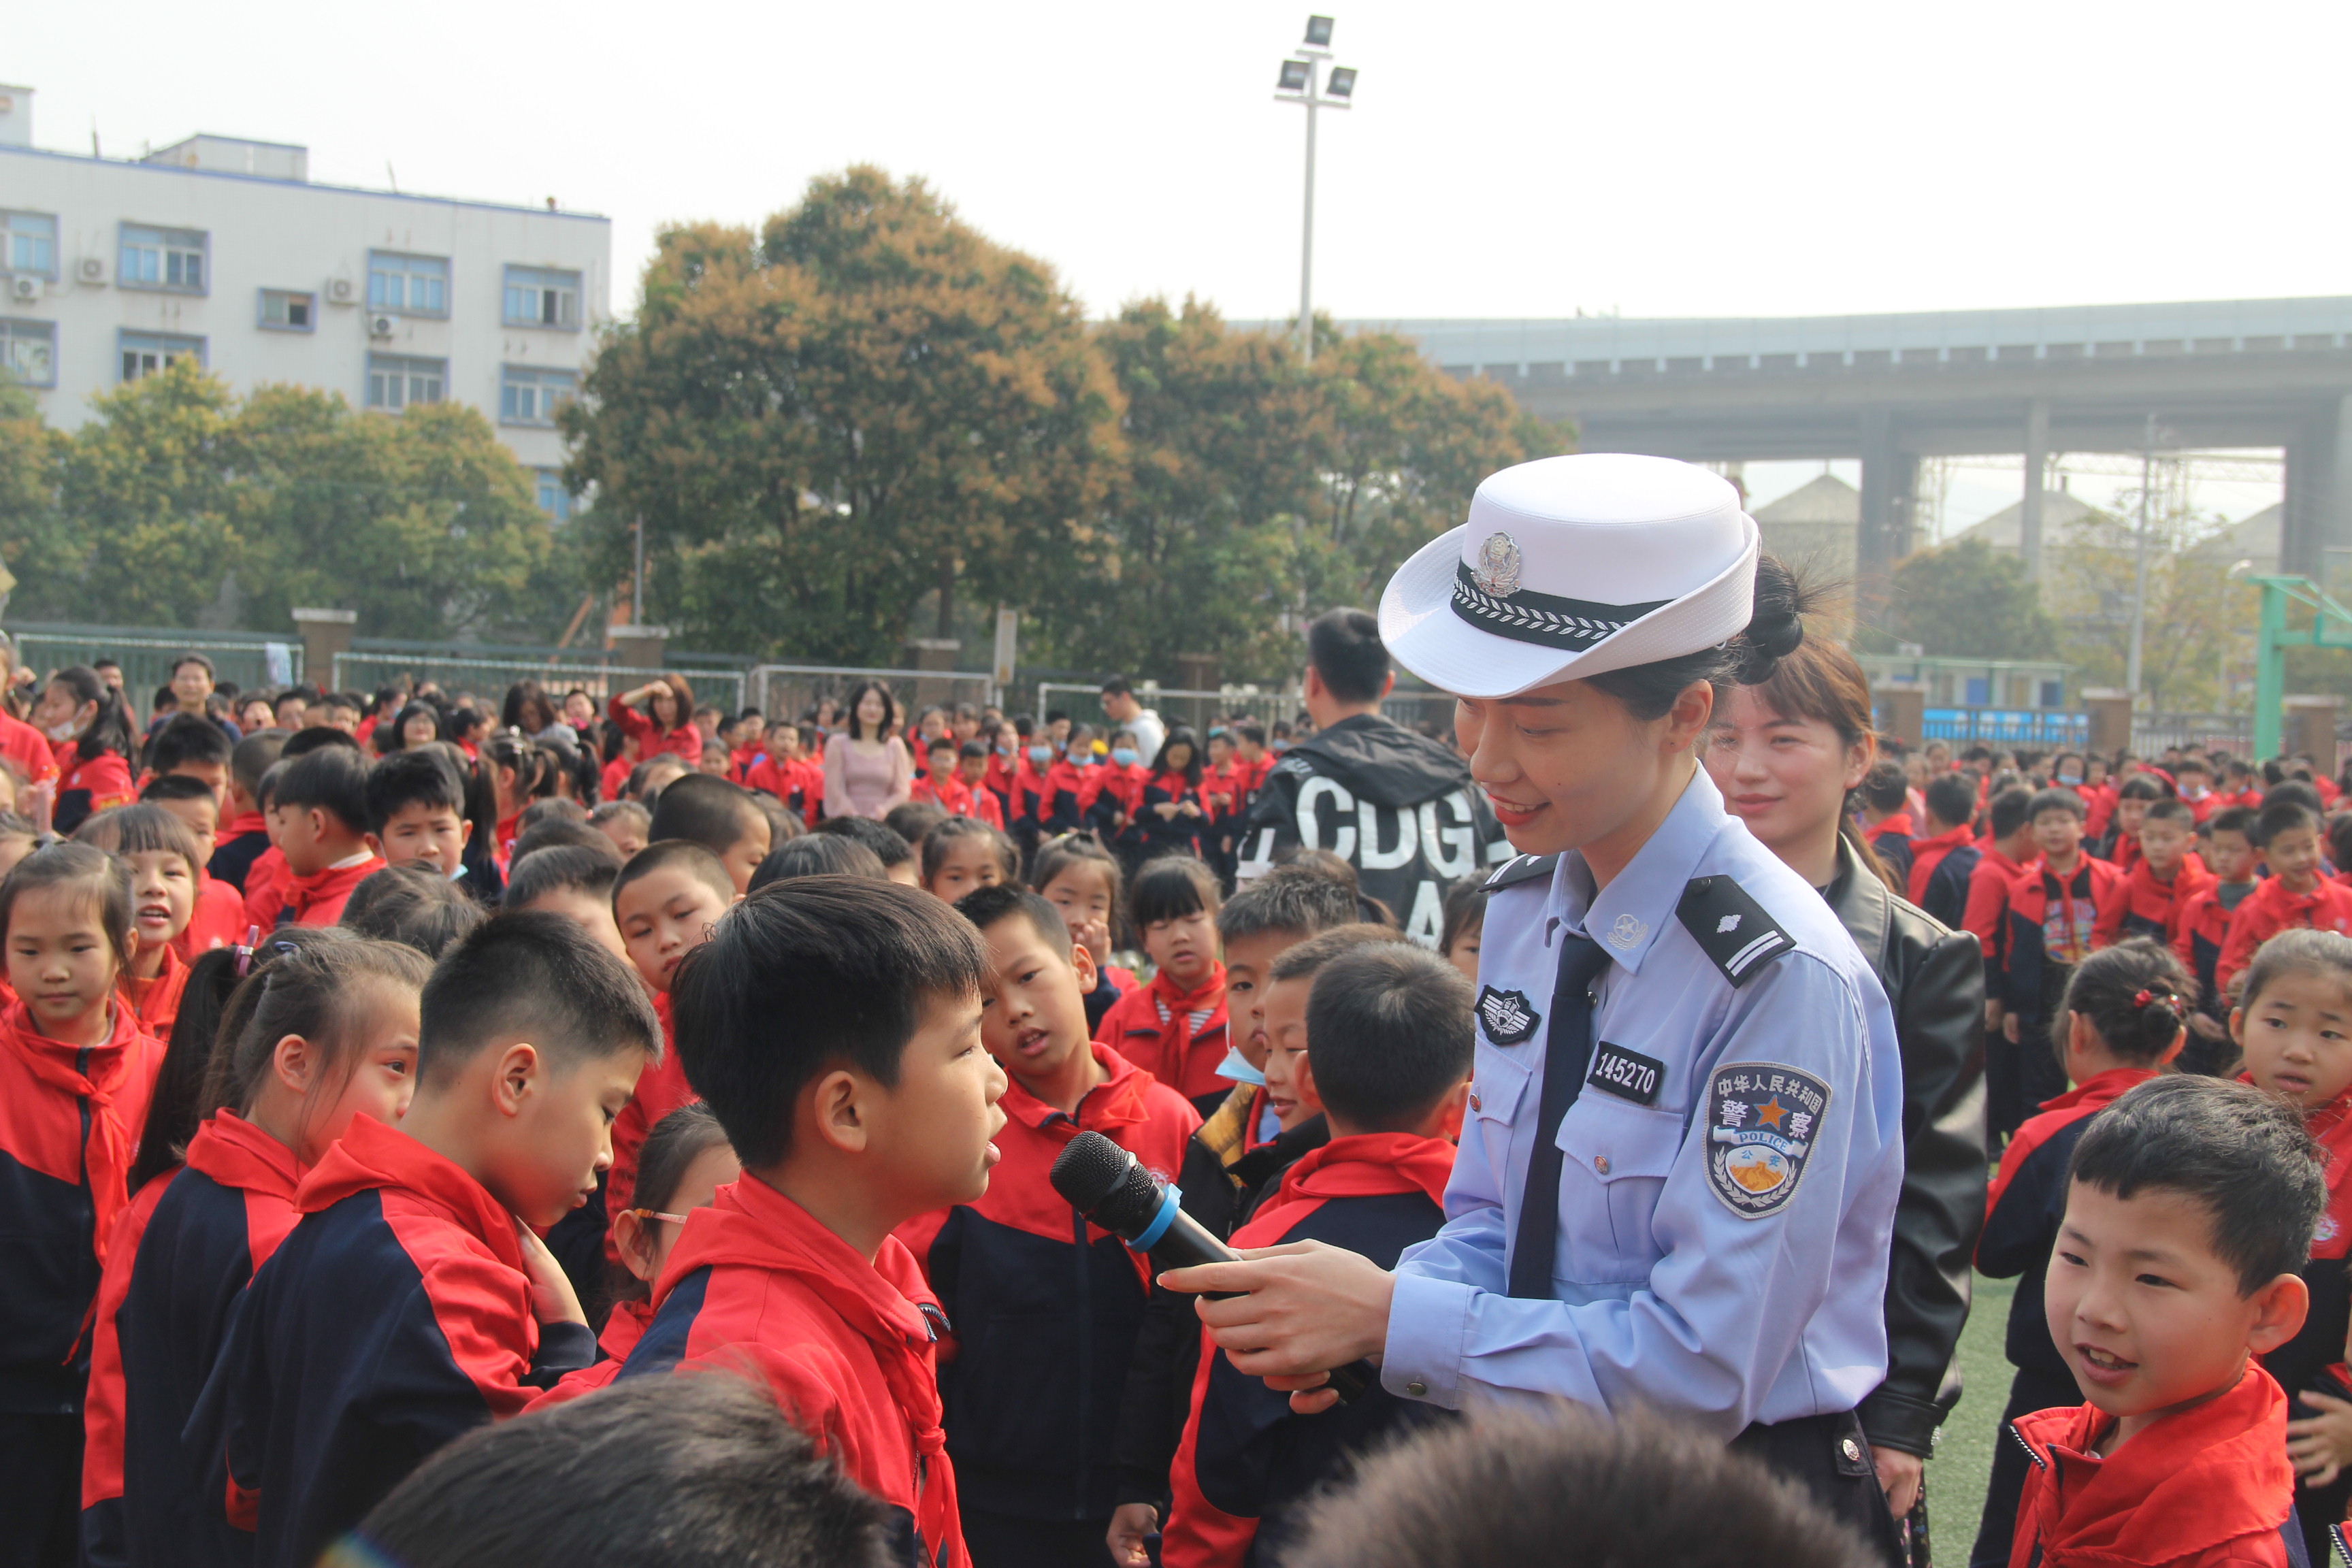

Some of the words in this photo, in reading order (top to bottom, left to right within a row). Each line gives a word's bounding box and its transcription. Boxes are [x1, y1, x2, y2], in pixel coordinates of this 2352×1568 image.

[1296, 776, 1476, 879] CDG
[1596, 1052, 1656, 1094] 145270
[1718, 1075, 1823, 1115] 中华人民共和国
[1740, 1132, 1786, 1152] POLICE
